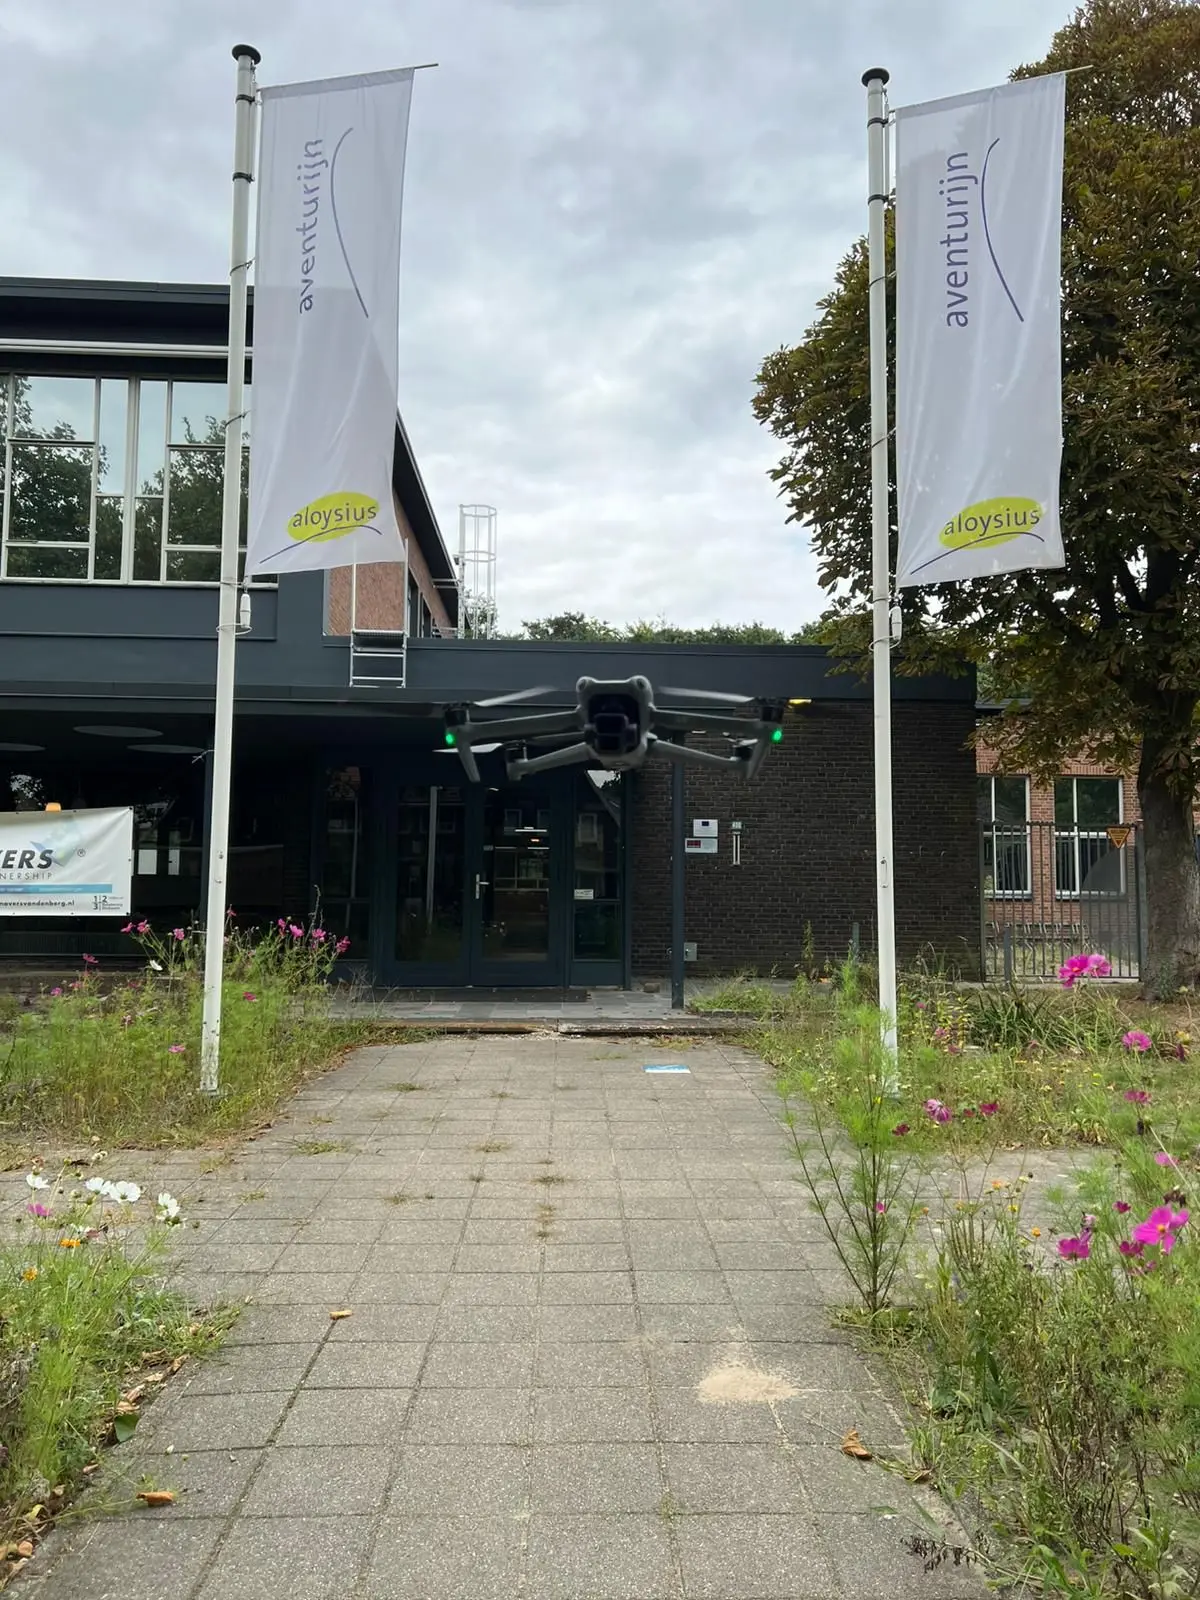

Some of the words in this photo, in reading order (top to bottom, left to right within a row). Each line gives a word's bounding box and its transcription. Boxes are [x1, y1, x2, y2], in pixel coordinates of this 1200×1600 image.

[295, 139, 329, 314] aventurijn
[938, 152, 979, 328] aventurijn
[292, 502, 377, 530] aloysius
[944, 508, 1041, 537] aloysius
[0, 849, 53, 869] ERS
